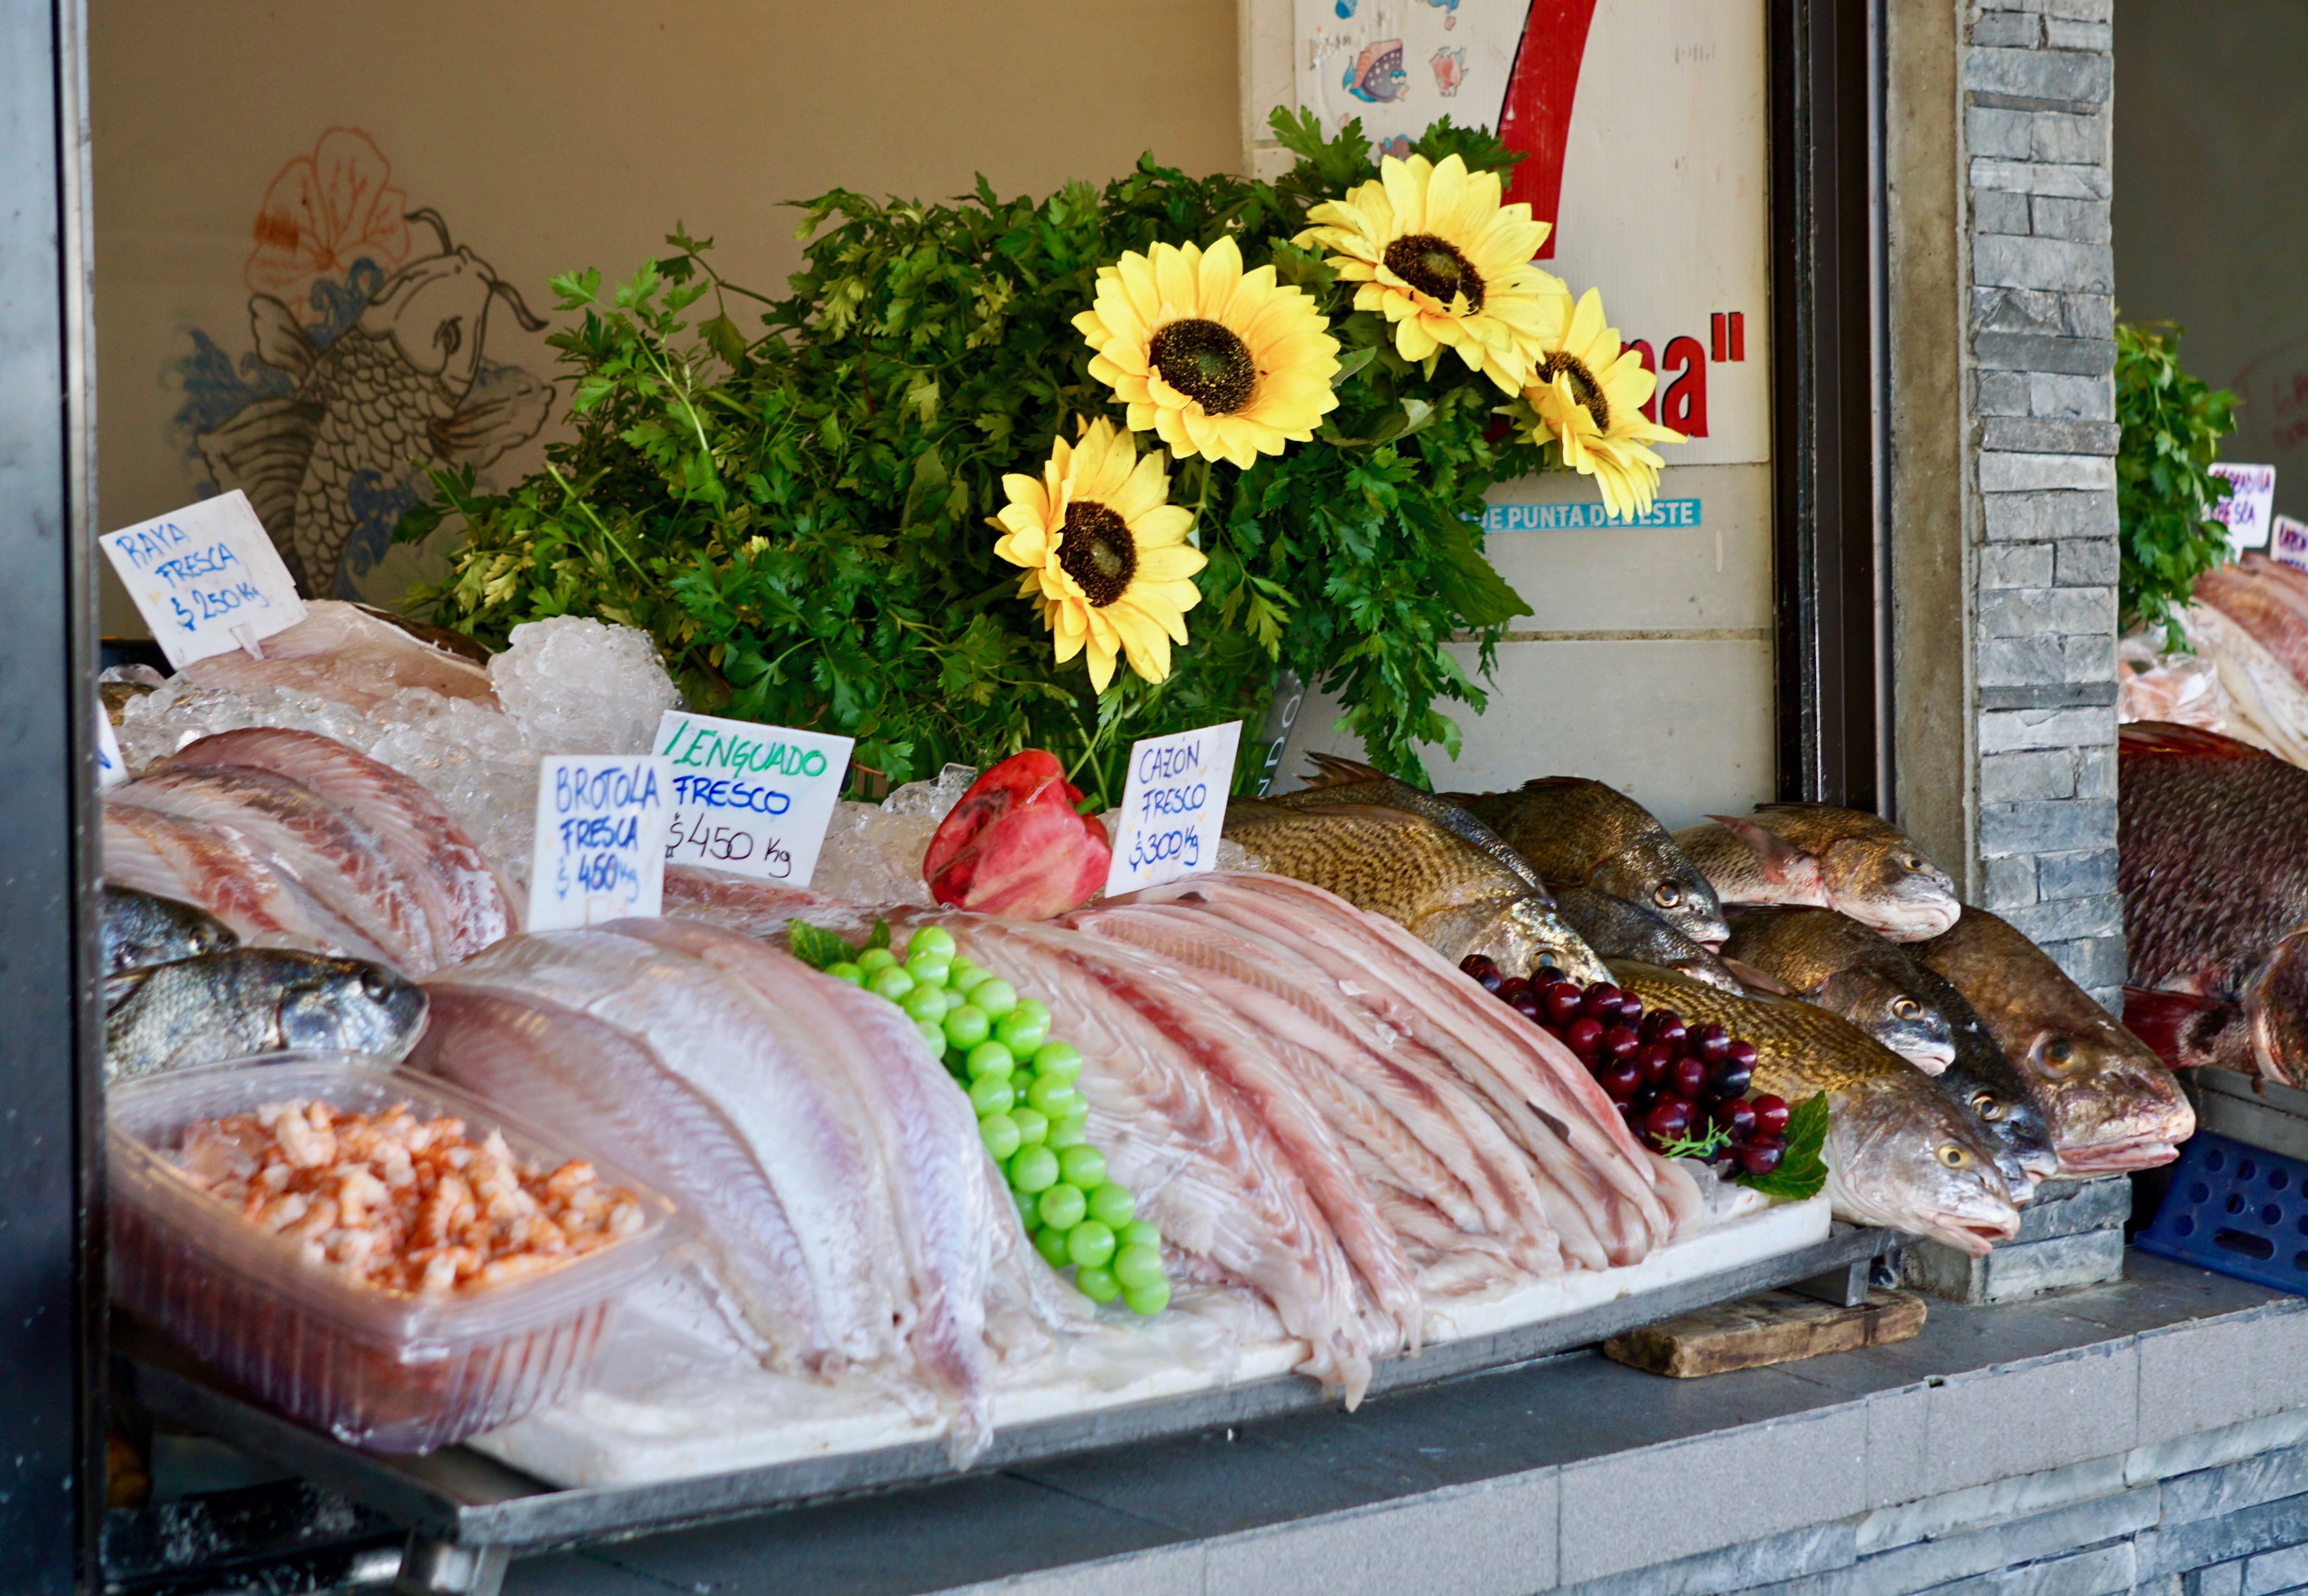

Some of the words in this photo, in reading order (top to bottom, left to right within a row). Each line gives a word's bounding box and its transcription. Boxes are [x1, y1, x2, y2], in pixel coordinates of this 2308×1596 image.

[1508, 504, 1584, 529] PUNTA
[1639, 502, 1694, 525] ESTE
[116, 522, 190, 569] RAYA
[155, 542, 240, 589] FRESCA
[662, 719, 827, 779] LENGUADO
[556, 763, 661, 813] BROTOLA
[672, 775, 791, 815] FRESCO
[1141, 783, 1207, 824] FRESCO
[559, 815, 638, 856] FRESCA
